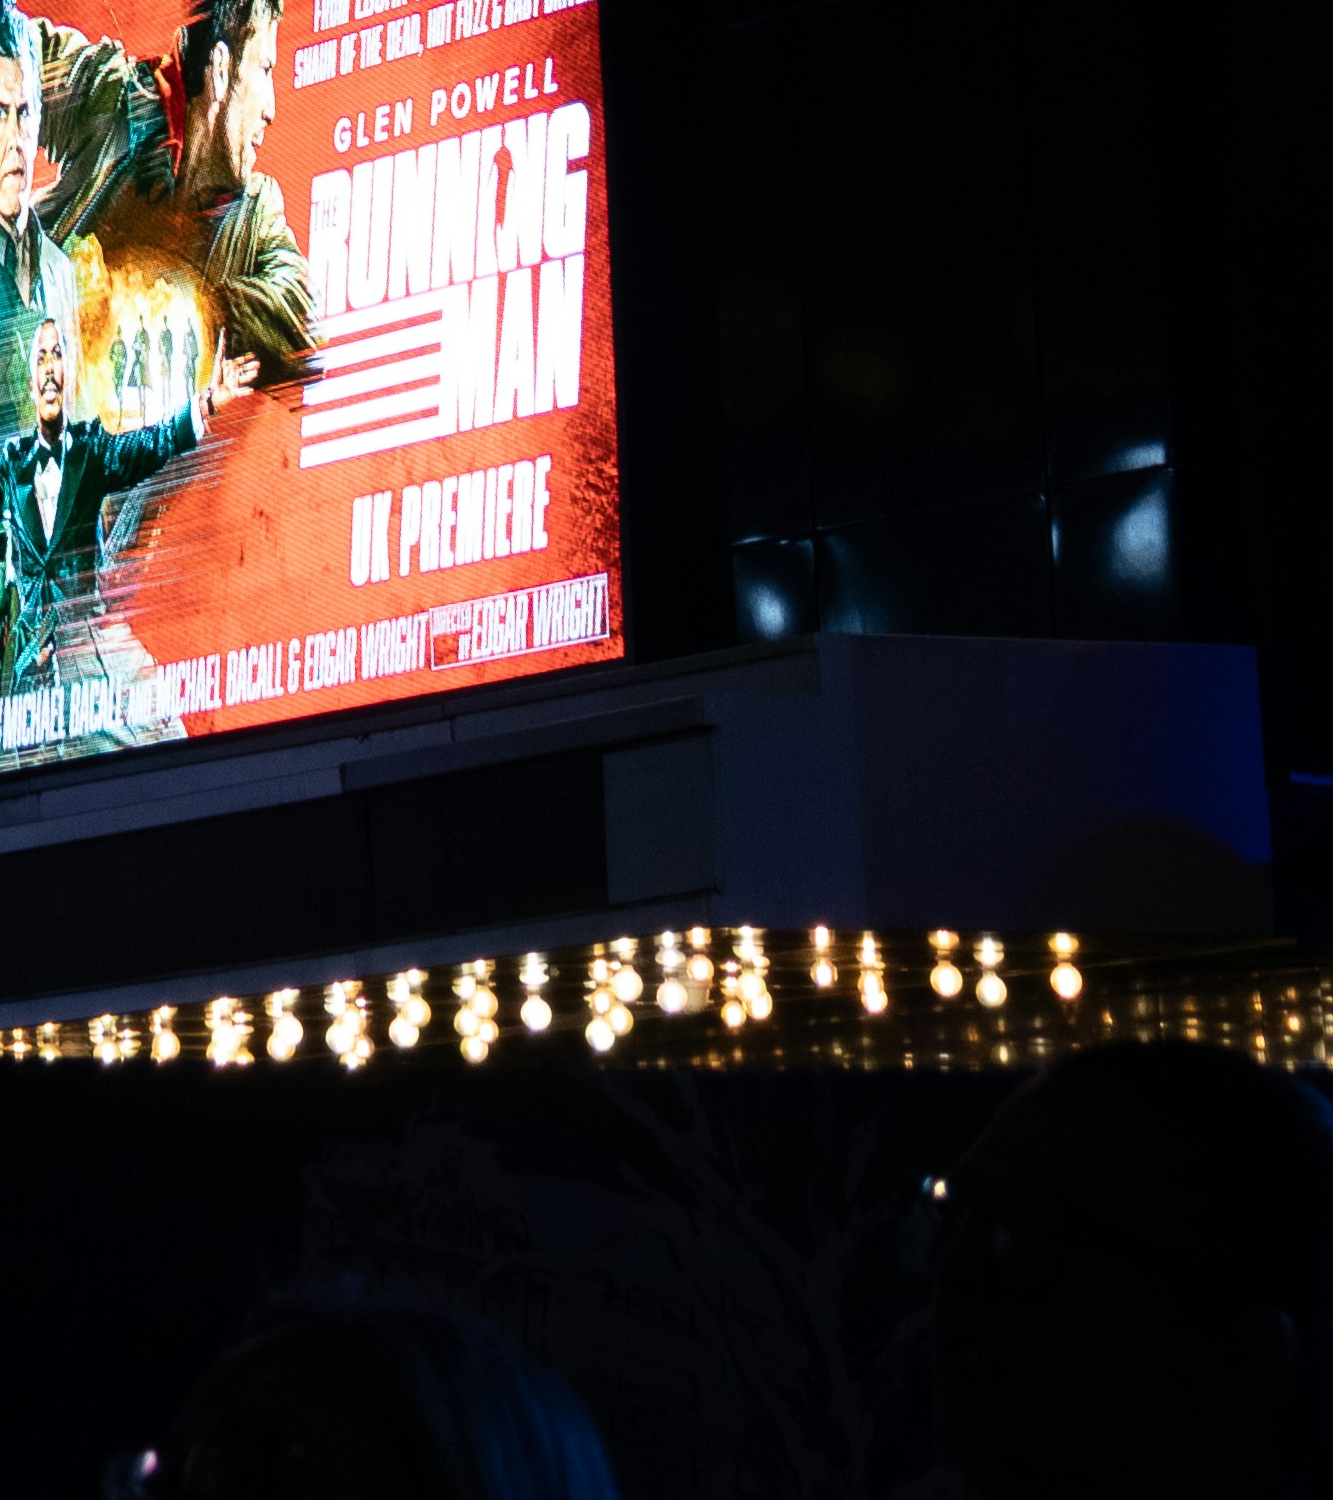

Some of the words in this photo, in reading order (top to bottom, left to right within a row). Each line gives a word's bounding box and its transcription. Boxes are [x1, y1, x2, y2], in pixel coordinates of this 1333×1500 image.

[333, 99, 413, 154] GLEN
[430, 56, 560, 126] POWELL
[340, 32, 359, 77] OF
[359, 24, 384, 70] THE
[308, 100, 591, 318] RUNNING
[349, 487, 394, 588] UK
[399, 453, 553, 578] PREMIERE
[471, 595, 528, 658] EDGAR
[532, 579, 606, 647] WRIGHT
[3, 686, 66, 749] MICHAEL
[69, 673, 125, 738] BACALL
[156, 653, 222, 717] MICHAEL
[225, 635, 284, 702] BACALL
[286, 631, 302, 695] &
[303, 622, 357, 690] EDGAR
[359, 610, 430, 678] WRIGHT
